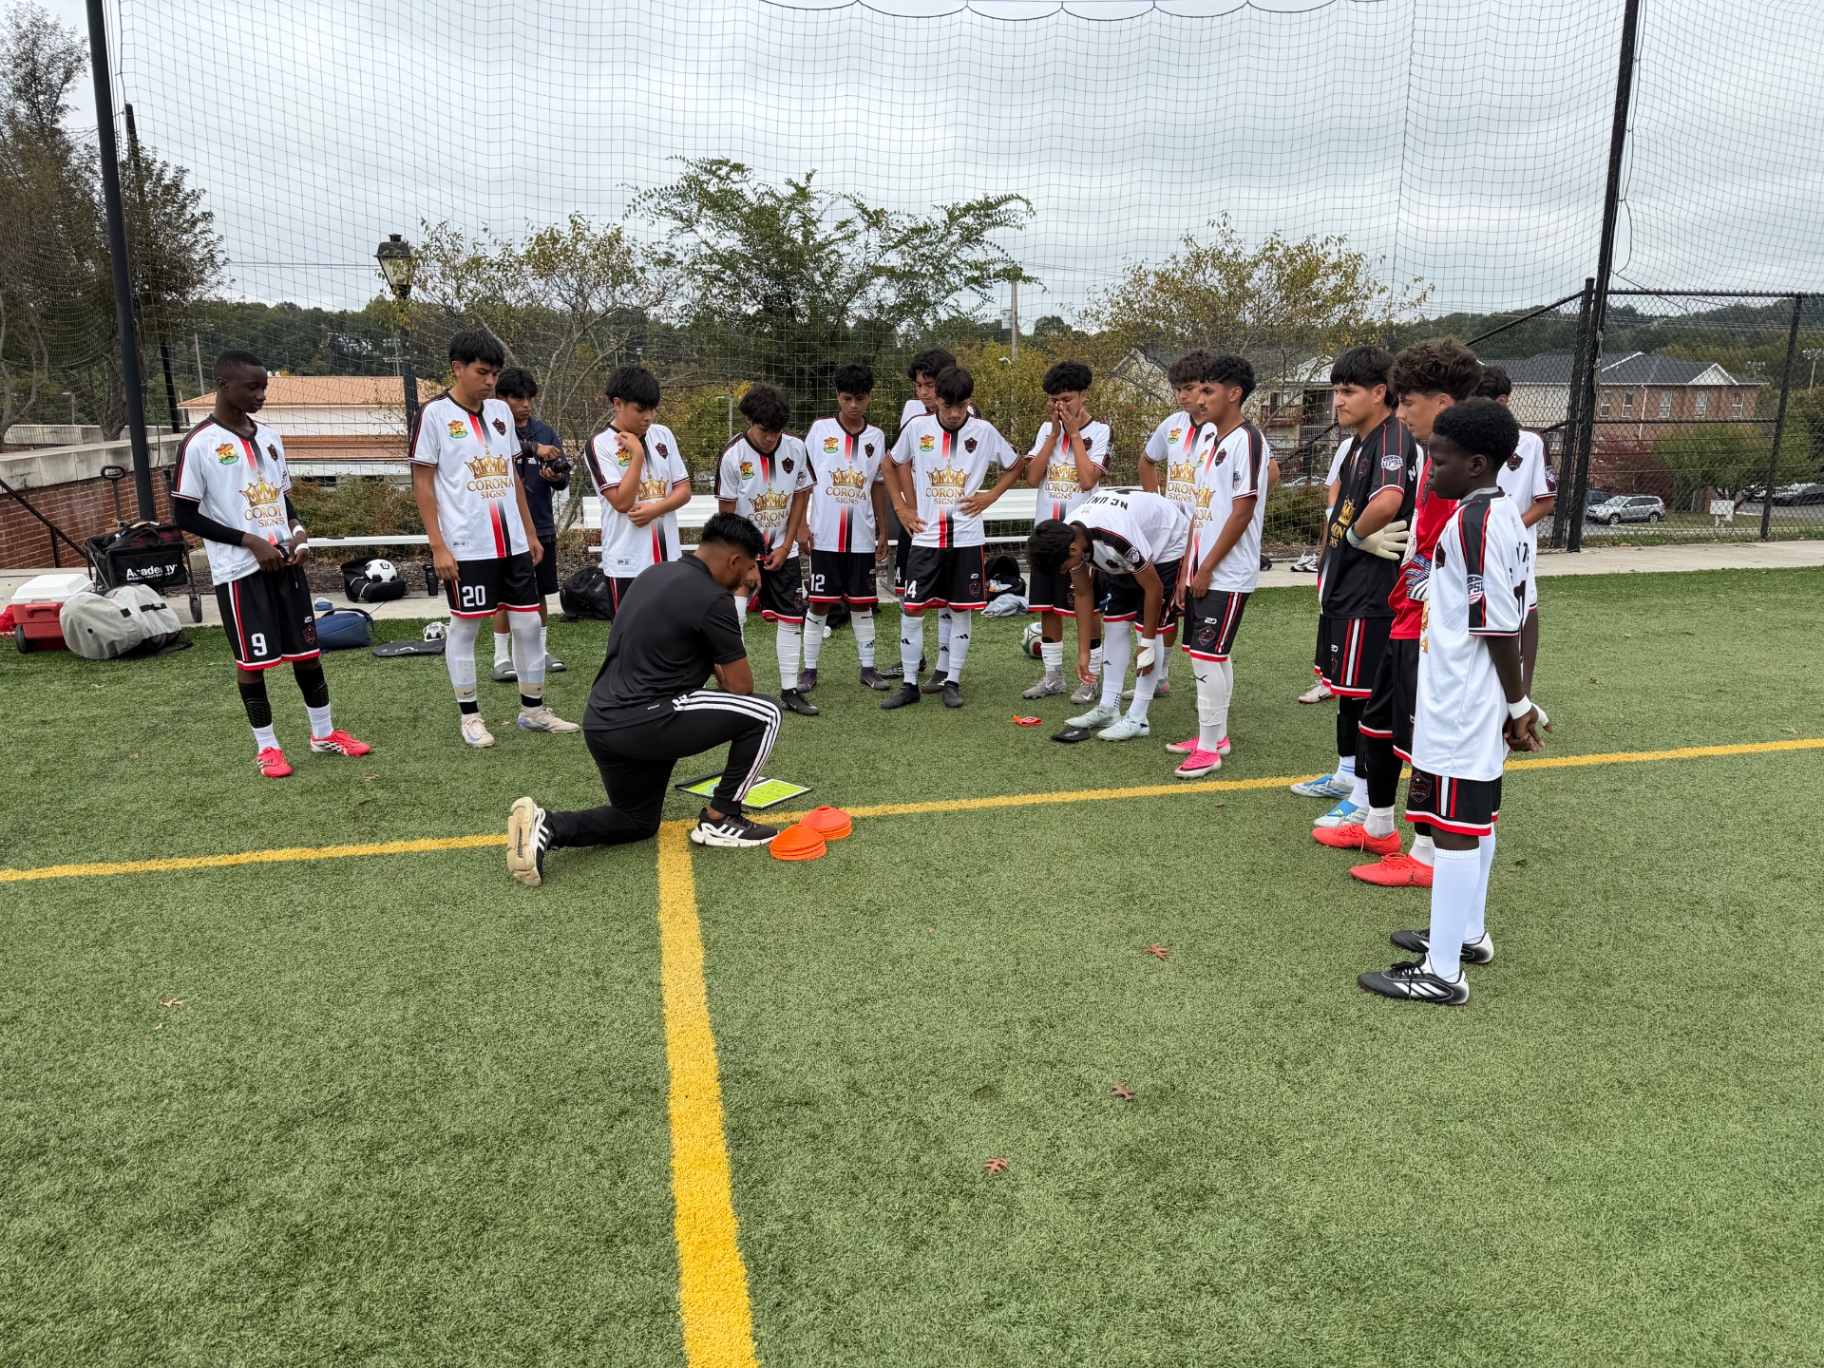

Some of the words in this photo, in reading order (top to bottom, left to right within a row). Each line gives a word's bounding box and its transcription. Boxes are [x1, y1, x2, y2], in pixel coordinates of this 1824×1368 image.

[466, 478, 514, 492] CORONA
[481, 489, 507, 500] SIGNS
[825, 486, 867, 501] CORONA
[1049, 492, 1073, 500] SIGNS
[1168, 492, 1193, 503] SIGNS
[835, 496, 859, 505] SIGNS
[257, 516, 285, 528] SIGNS
[758, 520, 781, 529] SIGNS
[810, 573, 826, 593] 12
[1468, 581, 1484, 595] PSL
[462, 585, 486, 607] 20
[251, 633, 267, 656] 9
